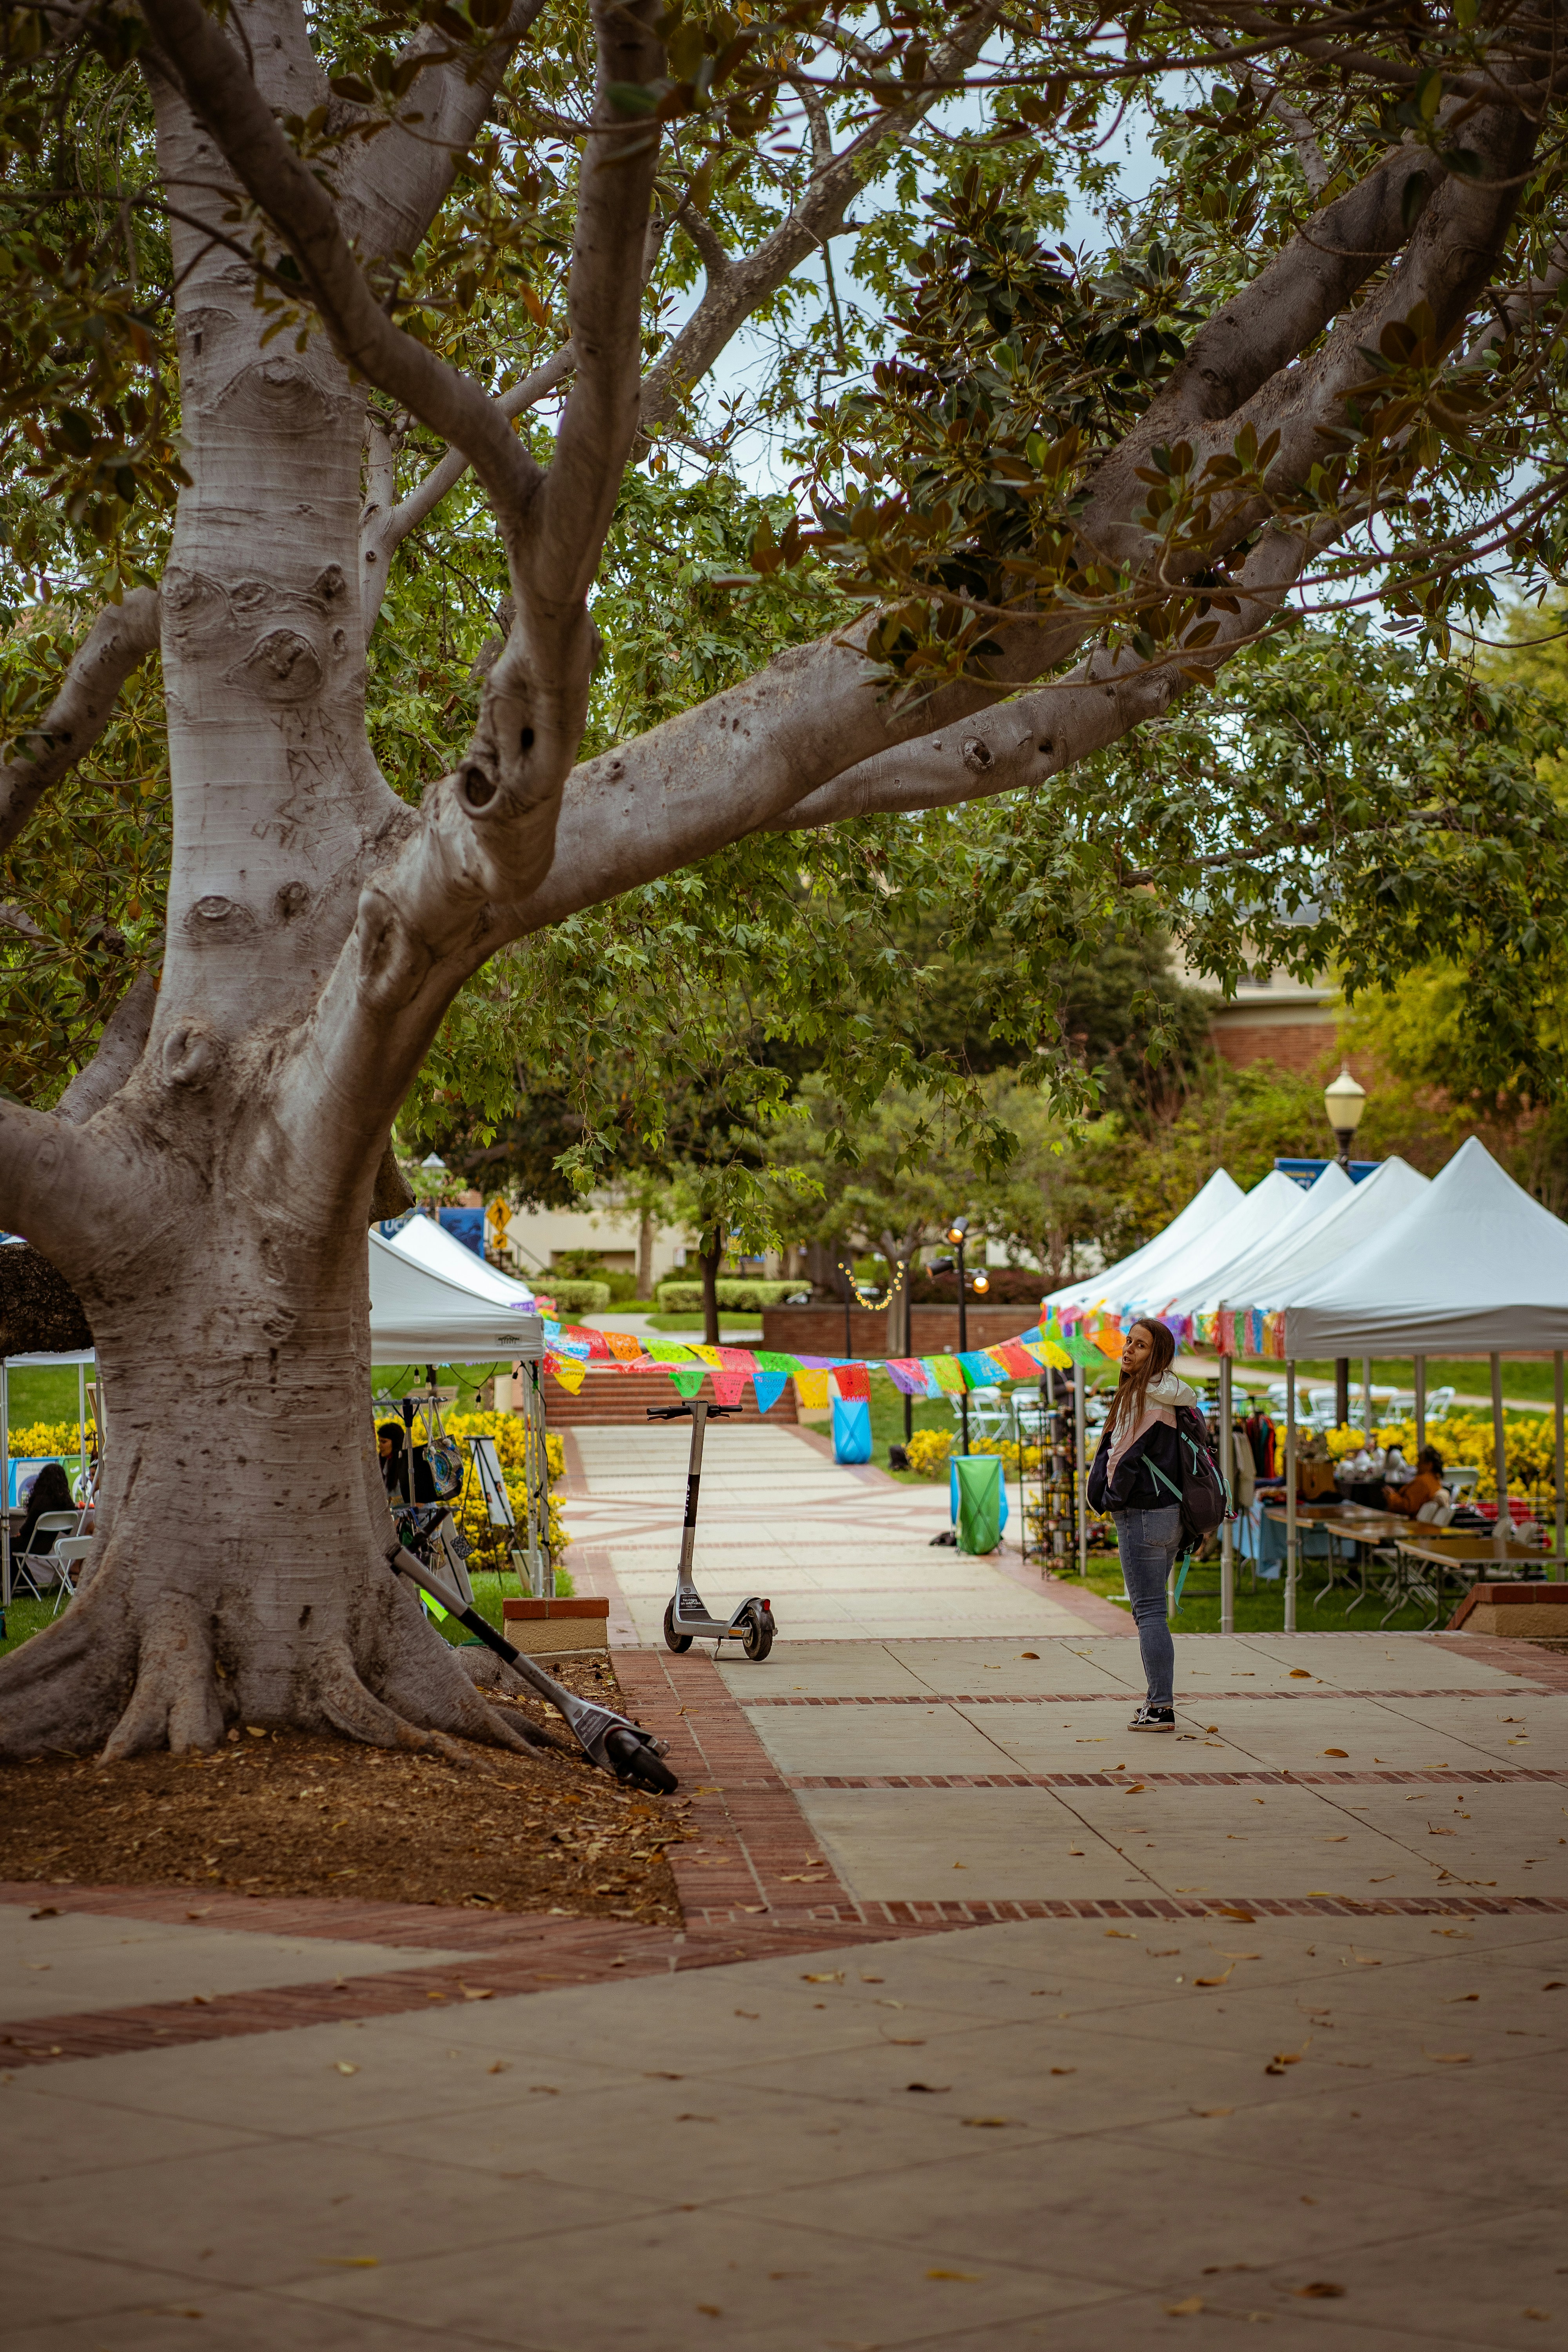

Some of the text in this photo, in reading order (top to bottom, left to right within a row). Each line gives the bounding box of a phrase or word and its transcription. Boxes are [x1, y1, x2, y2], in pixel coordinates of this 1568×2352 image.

[385, 1218, 408, 1232] UC
[586, 1715, 597, 1725] riding
[587, 1714, 603, 1733] sidewalks
